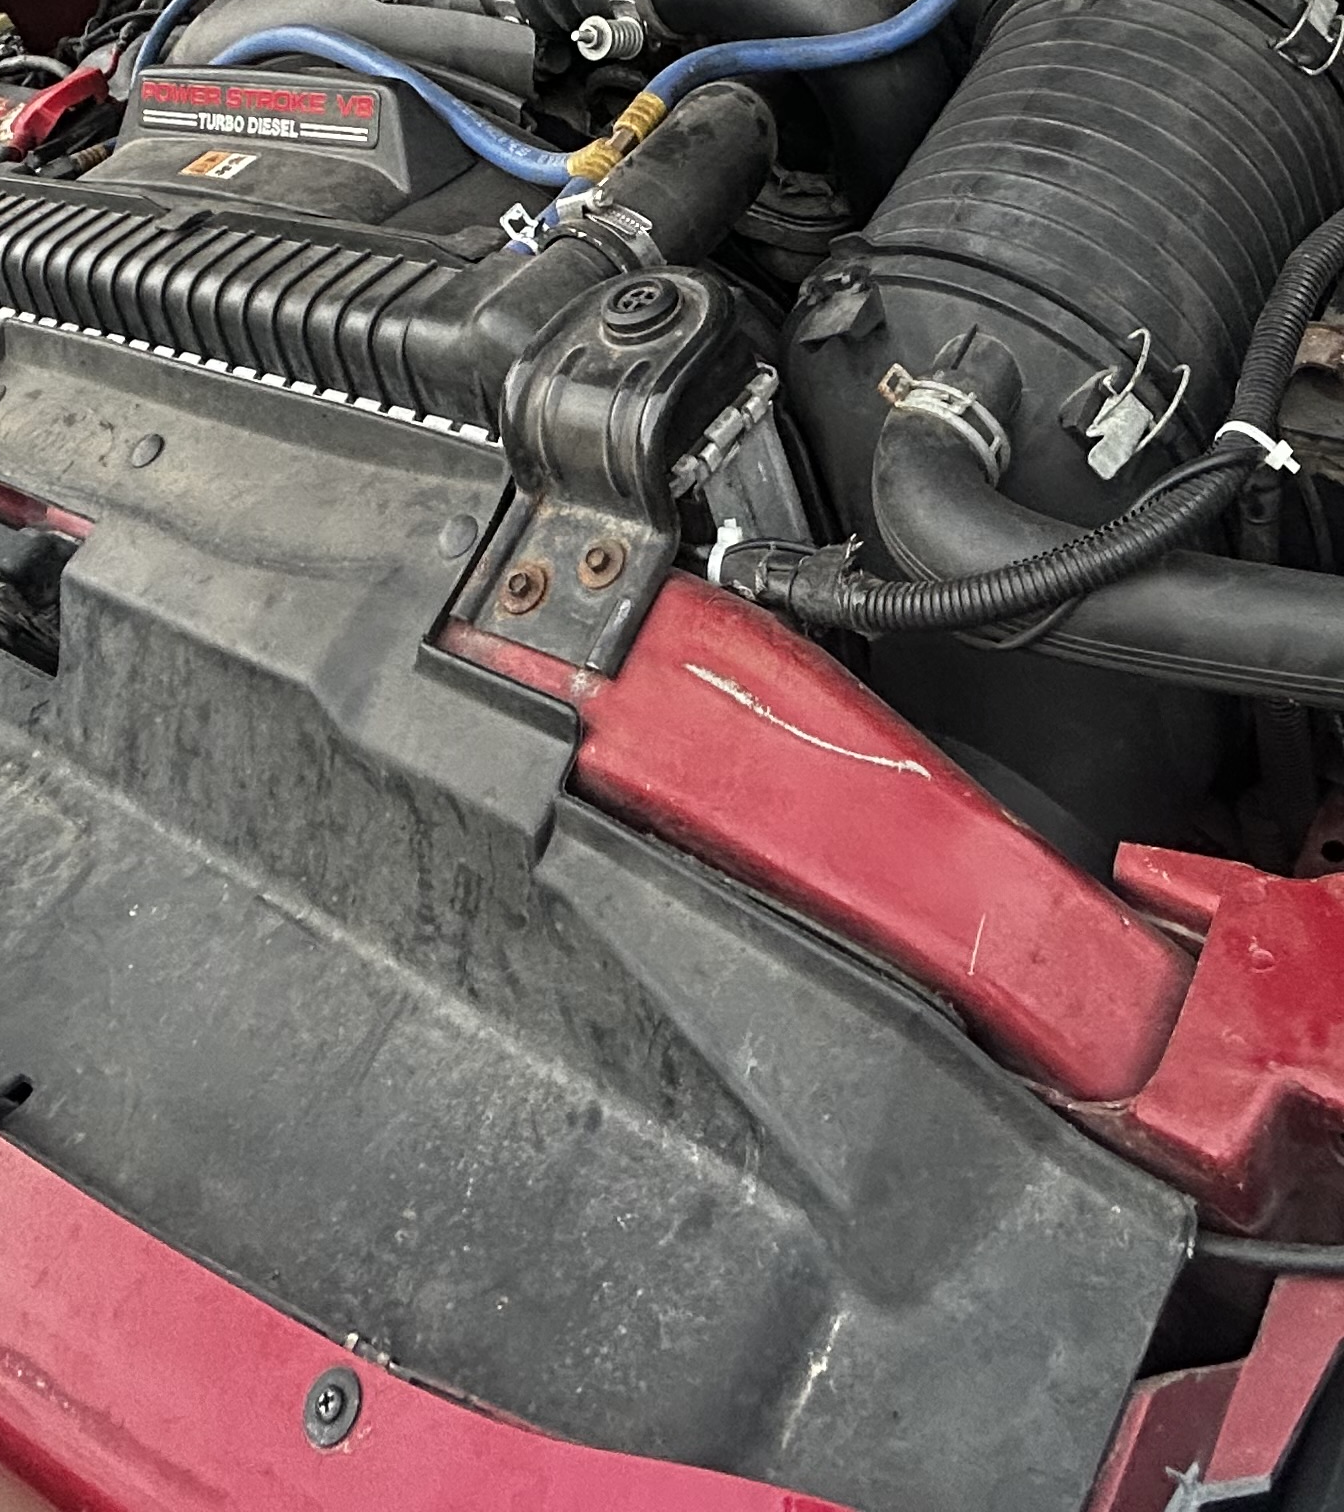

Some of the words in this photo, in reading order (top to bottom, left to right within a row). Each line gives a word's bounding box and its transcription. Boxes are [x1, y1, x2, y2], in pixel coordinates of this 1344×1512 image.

[141, 81, 221, 106] POWER
[226, 86, 327, 115] STROKE
[337, 93, 375, 119] V8
[198, 112, 245, 133] TURBO
[247, 117, 299, 138] DIESEL
